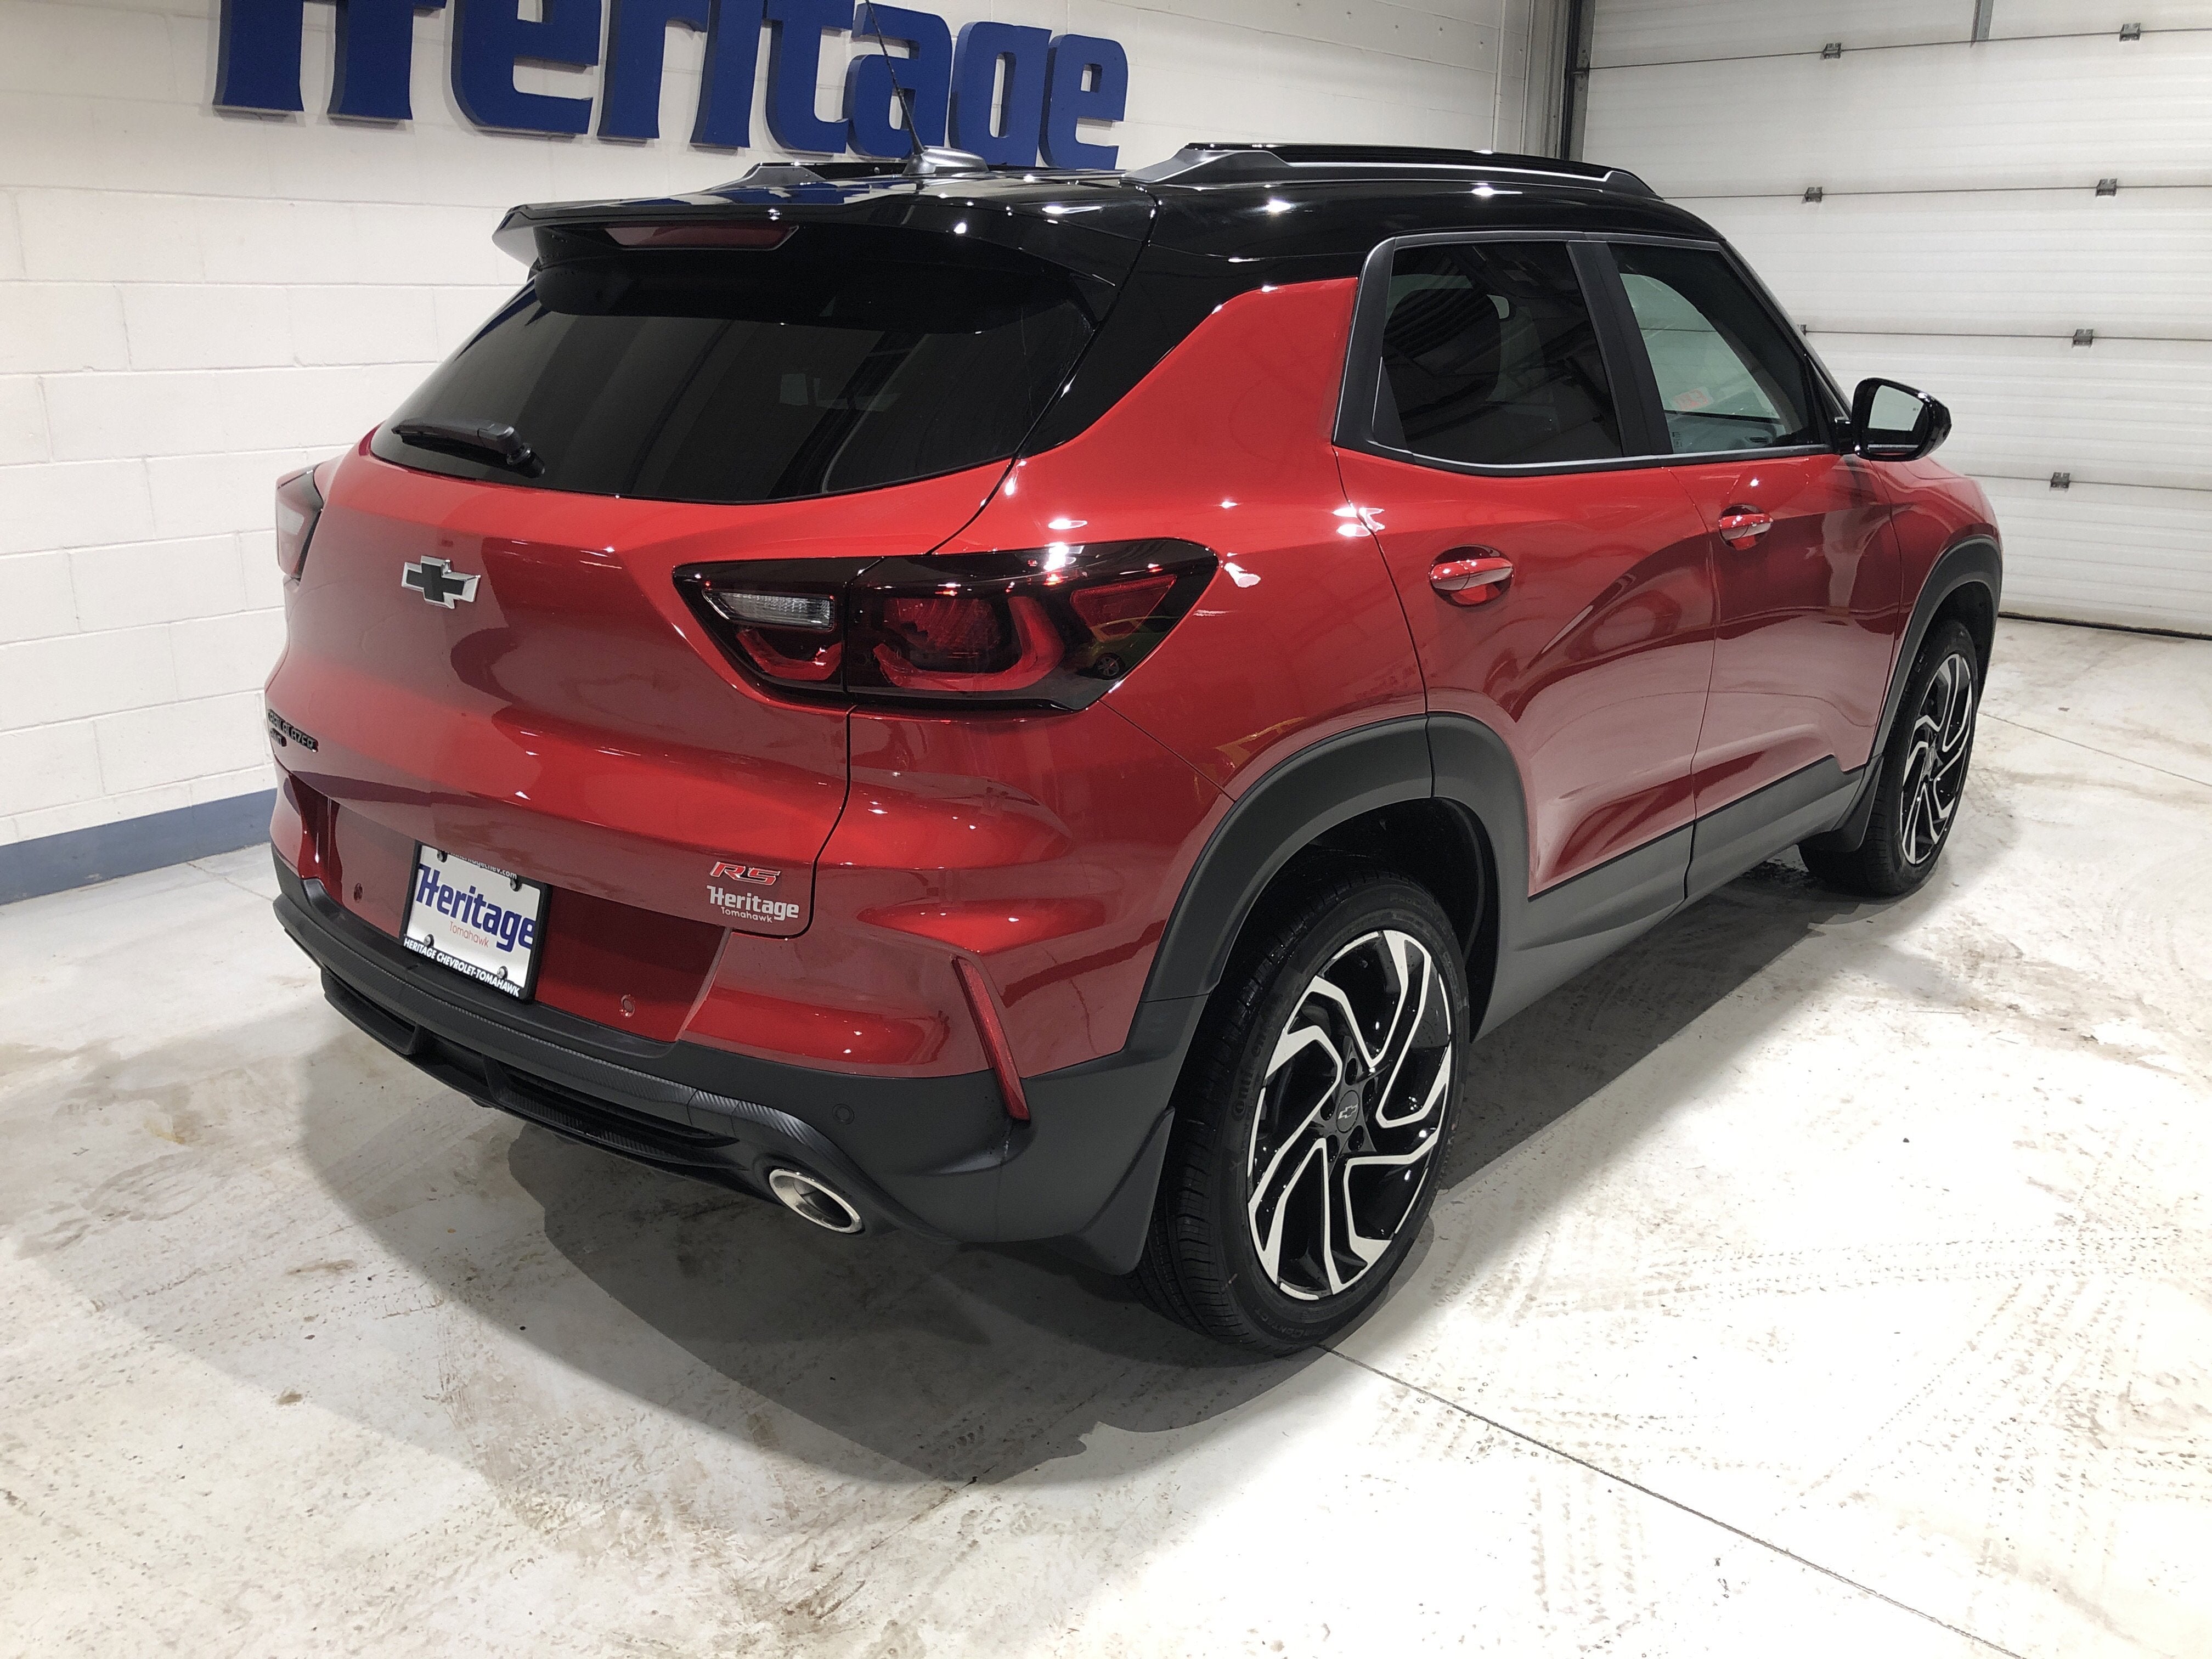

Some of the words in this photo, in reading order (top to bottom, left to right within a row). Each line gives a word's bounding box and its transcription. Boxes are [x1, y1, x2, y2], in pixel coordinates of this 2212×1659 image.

[709, 861, 781, 885] RS
[416, 863, 536, 952] Heritage
[707, 885, 799, 921] Heritage
[721, 906, 773, 923] Tomahawk
[449, 921, 489, 948] Tomahawk
[403, 937, 436, 960] HERITAGE
[436, 952, 521, 997] CHEVROLET-TOMAHAWK
